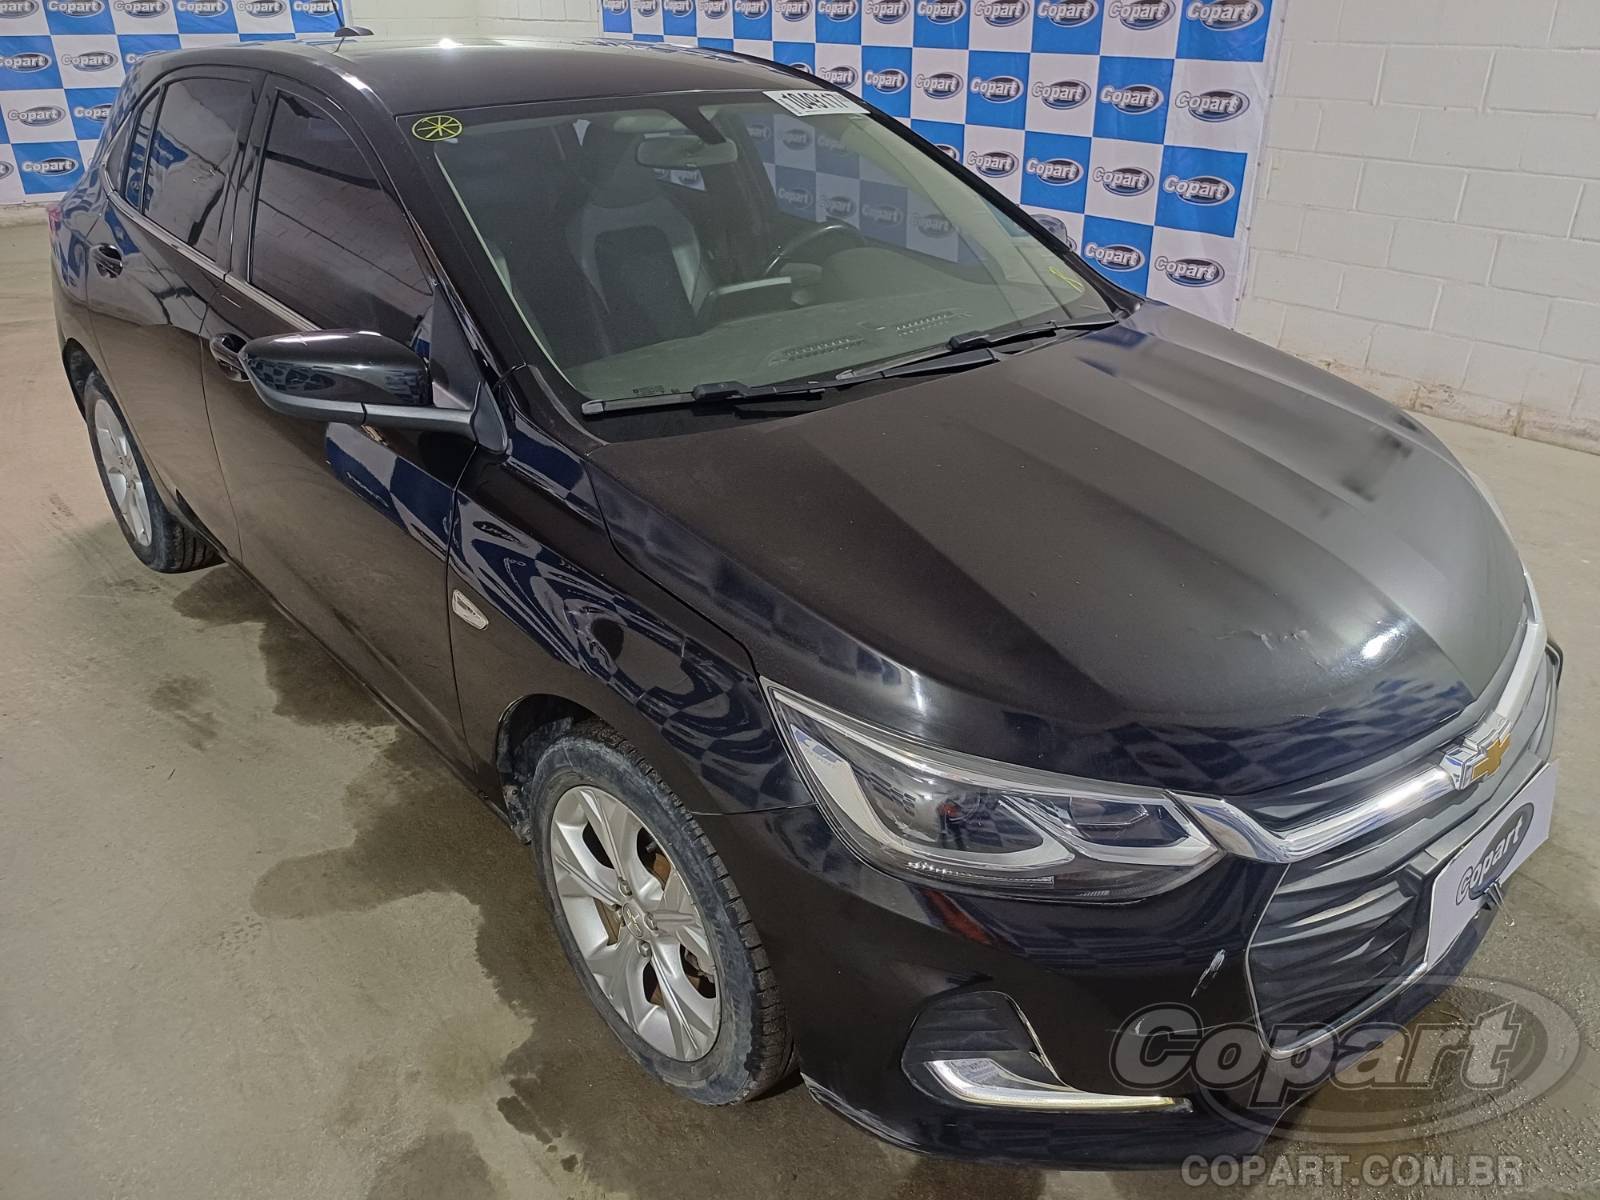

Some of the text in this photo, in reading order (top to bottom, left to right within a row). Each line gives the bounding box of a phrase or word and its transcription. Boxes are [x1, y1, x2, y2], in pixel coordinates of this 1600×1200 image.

[0, 1, 31, 13] part
[48, 0, 99, 13] Copart
[115, 1, 163, 13] Copart
[177, 0, 223, 13] Copart
[238, 1, 280, 12] Copart
[294, 0, 334, 12] Copart
[735, 0, 764, 14] Copart
[775, 0, 807, 15] Copart
[818, 0, 853, 16] Copart
[866, 1, 904, 17] Copart
[918, 1, 960, 18] Copart
[975, 1, 1022, 20] Copart
[1038, 2, 1092, 22] Copart
[1109, 1, 1168, 22] Copart
[1187, 1, 1253, 25] Copart
[62, 54, 110, 67] Copart
[820, 66, 851, 83] Copart
[864, 70, 902, 89] Copart
[915, 74, 957, 93] Copart
[970, 78, 1018, 98] Copart
[1032, 81, 1083, 102] Copart
[1101, 86, 1156, 107] Copart
[1176, 91, 1238, 113] Copart
[8, 110, 58, 121] Copart
[74, 107, 110, 119] Copa
[22, 160, 72, 172] Copart
[967, 151, 1012, 171] Copart
[1026, 158, 1076, 179] Copart
[1093, 167, 1147, 189] Copart
[1164, 176, 1226, 200] Copart
[1086, 243, 1139, 266] Copart
[1155, 256, 1217, 280] Copart
[1456, 815, 1523, 905] Copart
